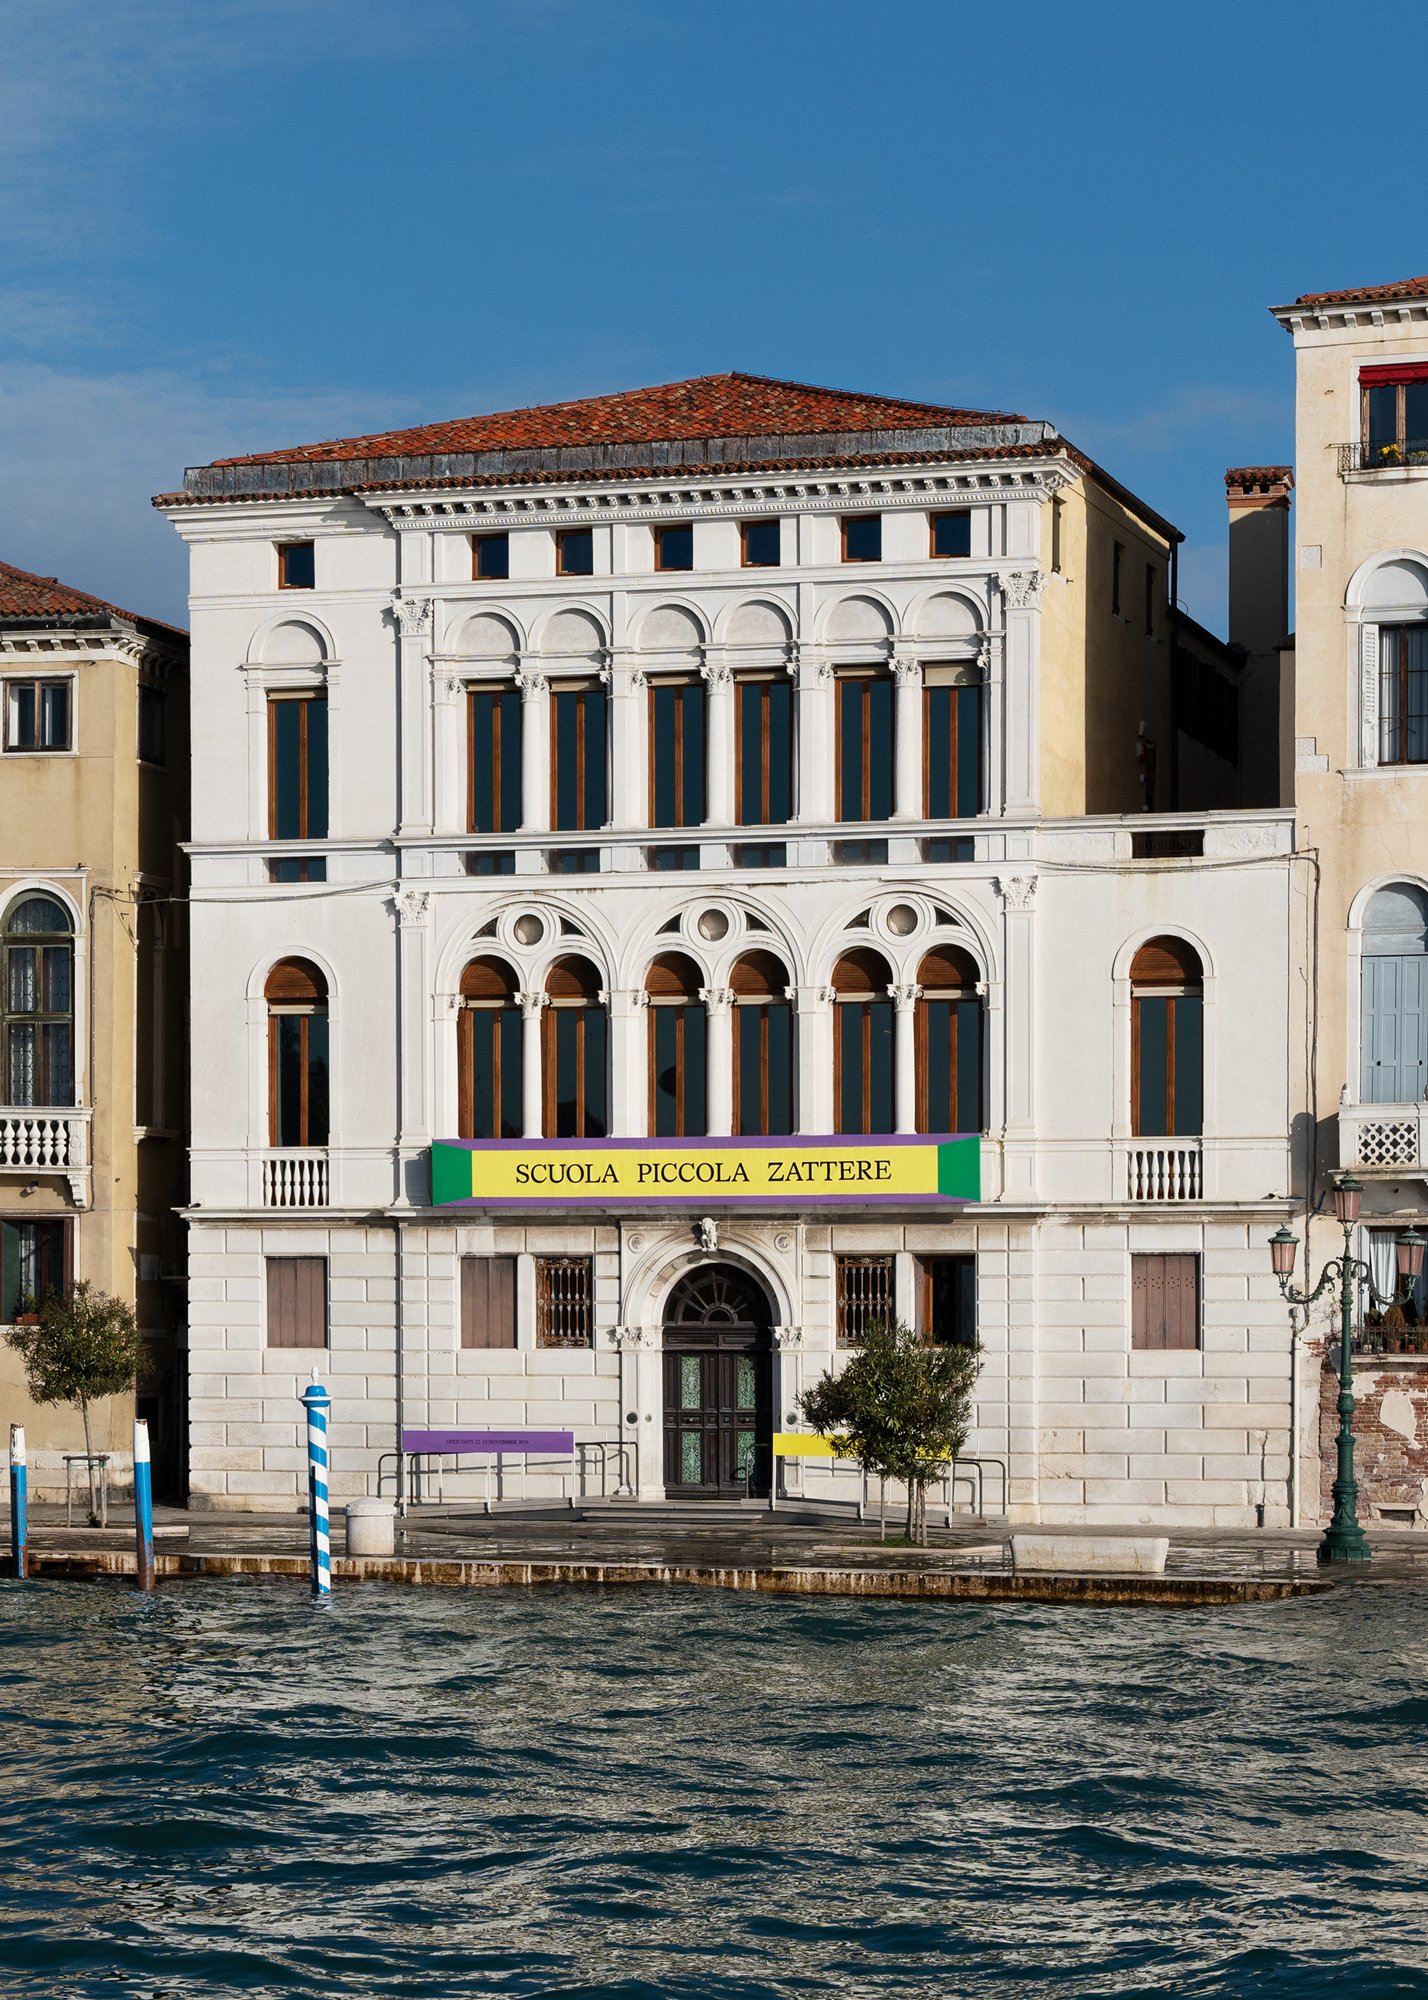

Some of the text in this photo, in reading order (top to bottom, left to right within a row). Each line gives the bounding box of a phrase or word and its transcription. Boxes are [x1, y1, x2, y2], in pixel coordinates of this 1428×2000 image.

[516, 1160, 892, 1184] SCUOLA PICCOLA ZATTERE
